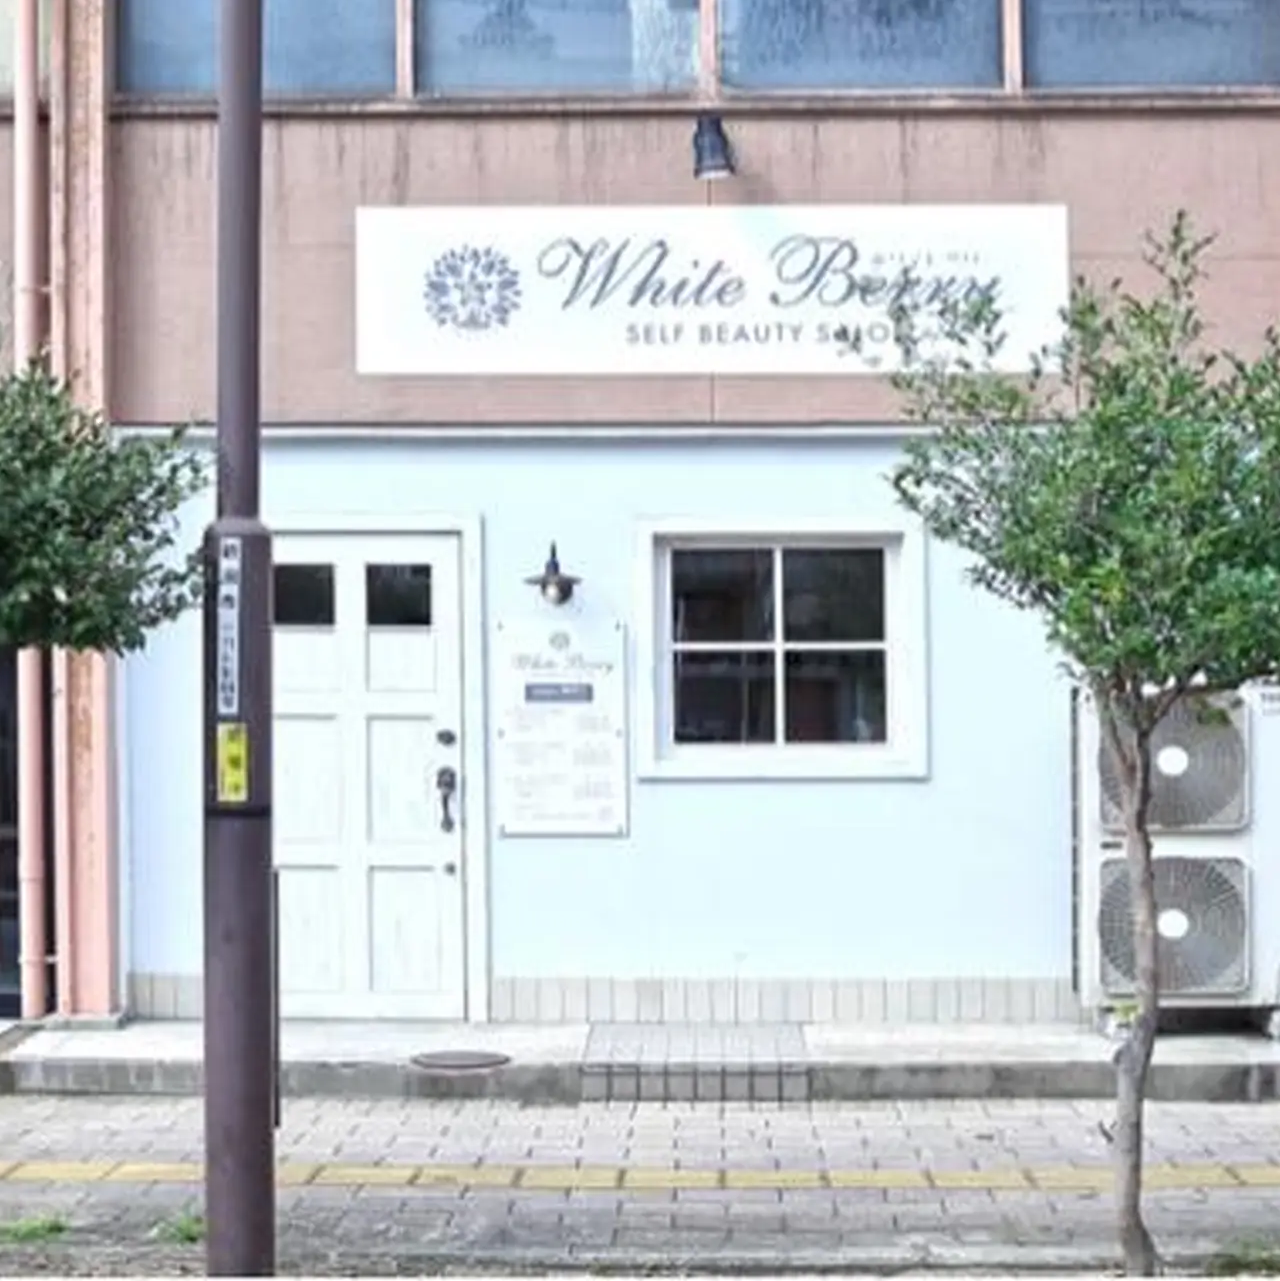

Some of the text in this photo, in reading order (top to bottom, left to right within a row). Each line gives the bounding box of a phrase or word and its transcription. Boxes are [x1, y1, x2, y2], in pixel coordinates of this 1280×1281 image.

[537, 235, 746, 309] White
[625, 322, 684, 344] SELF
[699, 322, 803, 344] BEAUTY
